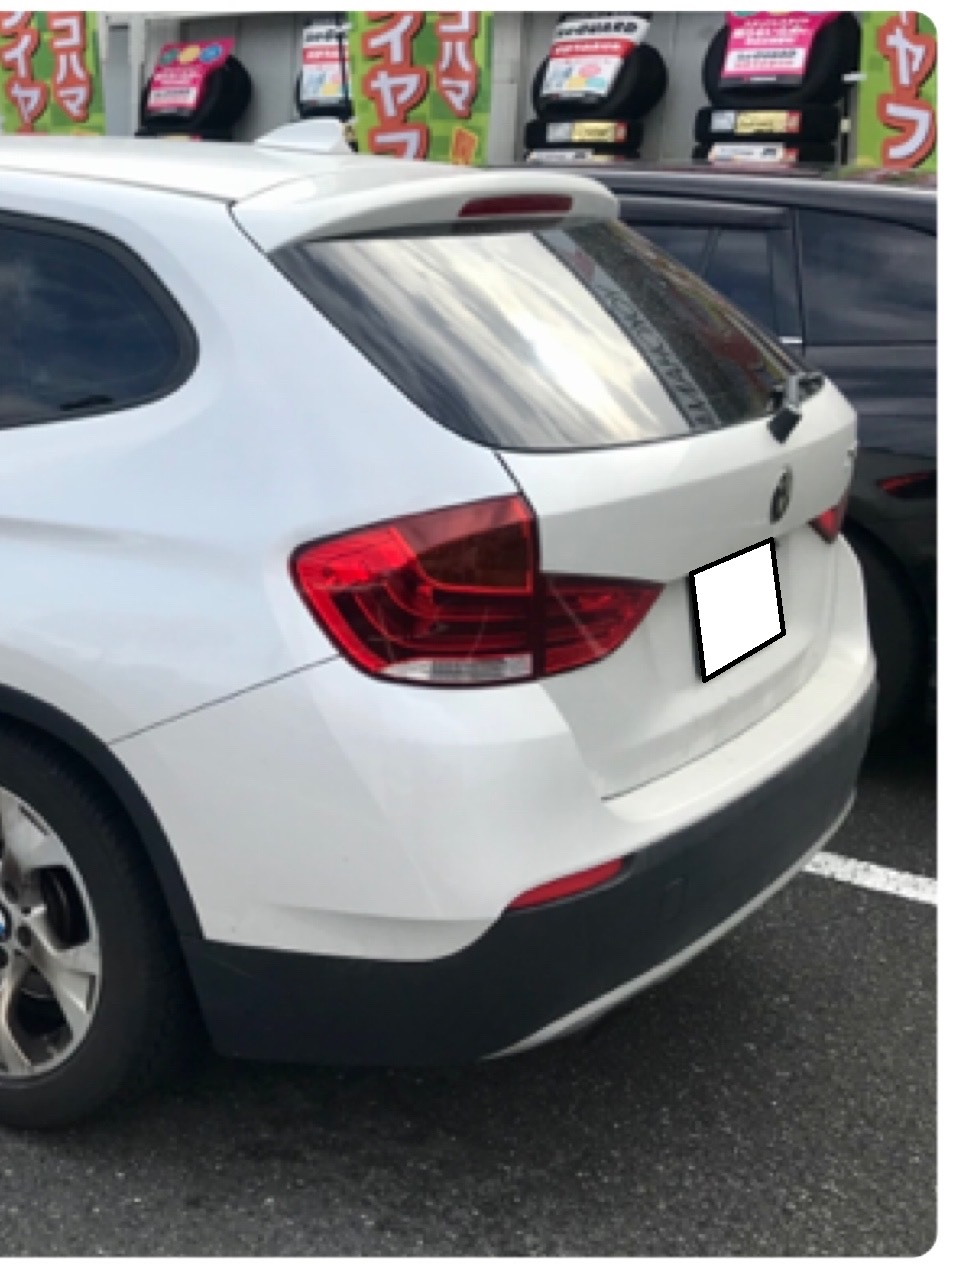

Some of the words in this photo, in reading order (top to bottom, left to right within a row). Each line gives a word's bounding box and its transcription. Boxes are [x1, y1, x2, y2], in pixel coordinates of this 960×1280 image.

[52, 16, 86, 116] コハマ
[886, 11, 930, 159] ヤフ
